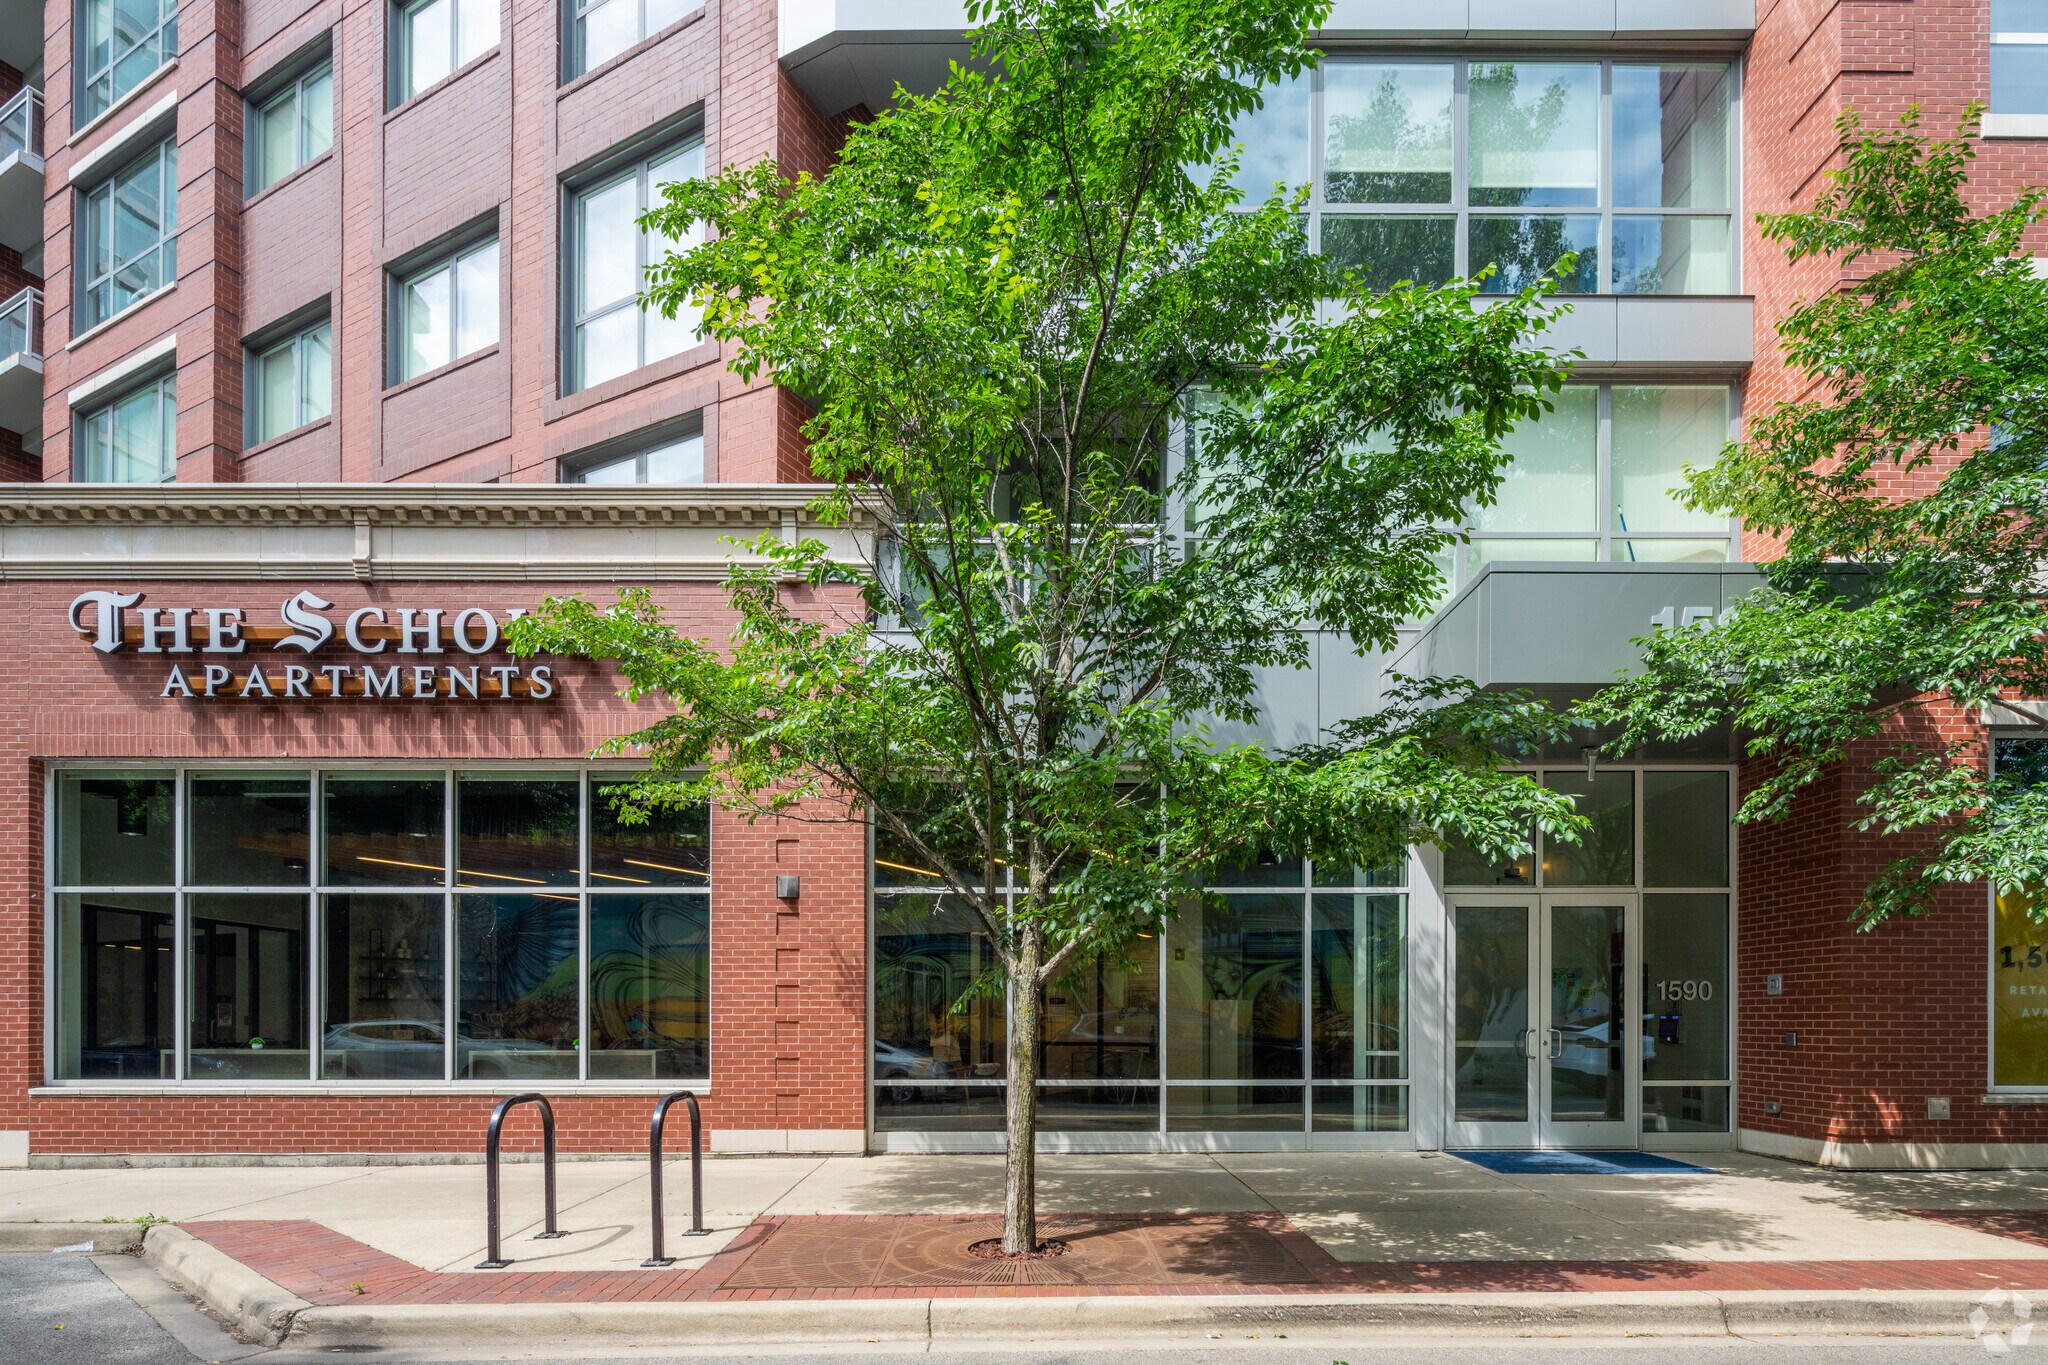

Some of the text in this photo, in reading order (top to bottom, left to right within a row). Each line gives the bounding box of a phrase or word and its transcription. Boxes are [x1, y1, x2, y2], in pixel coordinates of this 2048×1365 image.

[68, 589, 585, 655] THE SCHO
[1651, 606, 1736, 641] 15
[160, 664, 553, 699] APARTMENTS
[2000, 945, 2048, 972] 1,5
[1656, 980, 1713, 1001] 1590
